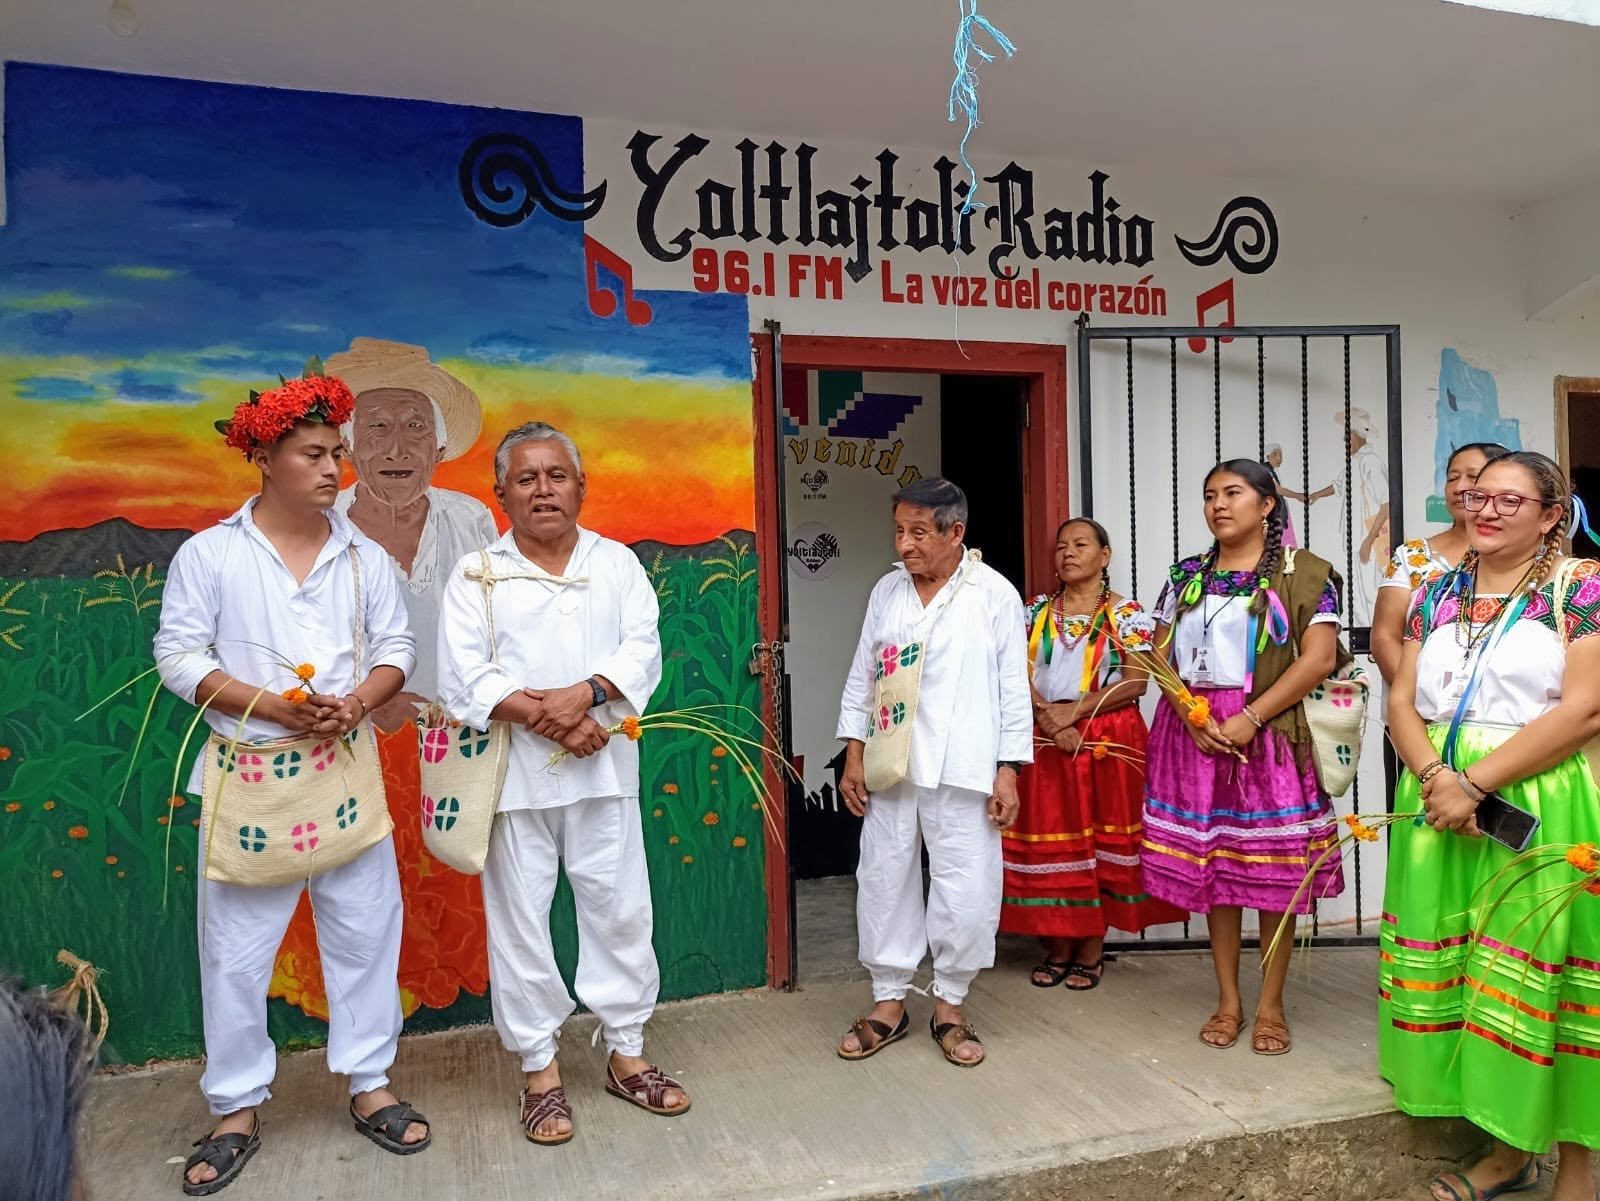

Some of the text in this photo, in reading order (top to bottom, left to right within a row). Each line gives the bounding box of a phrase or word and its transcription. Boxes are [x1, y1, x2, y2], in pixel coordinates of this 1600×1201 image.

[625, 129, 1155, 284] Yoltlajtoli Radio
[692, 247, 844, 300] 96.1 FM
[881, 259, 1167, 316] La voz del corazón
